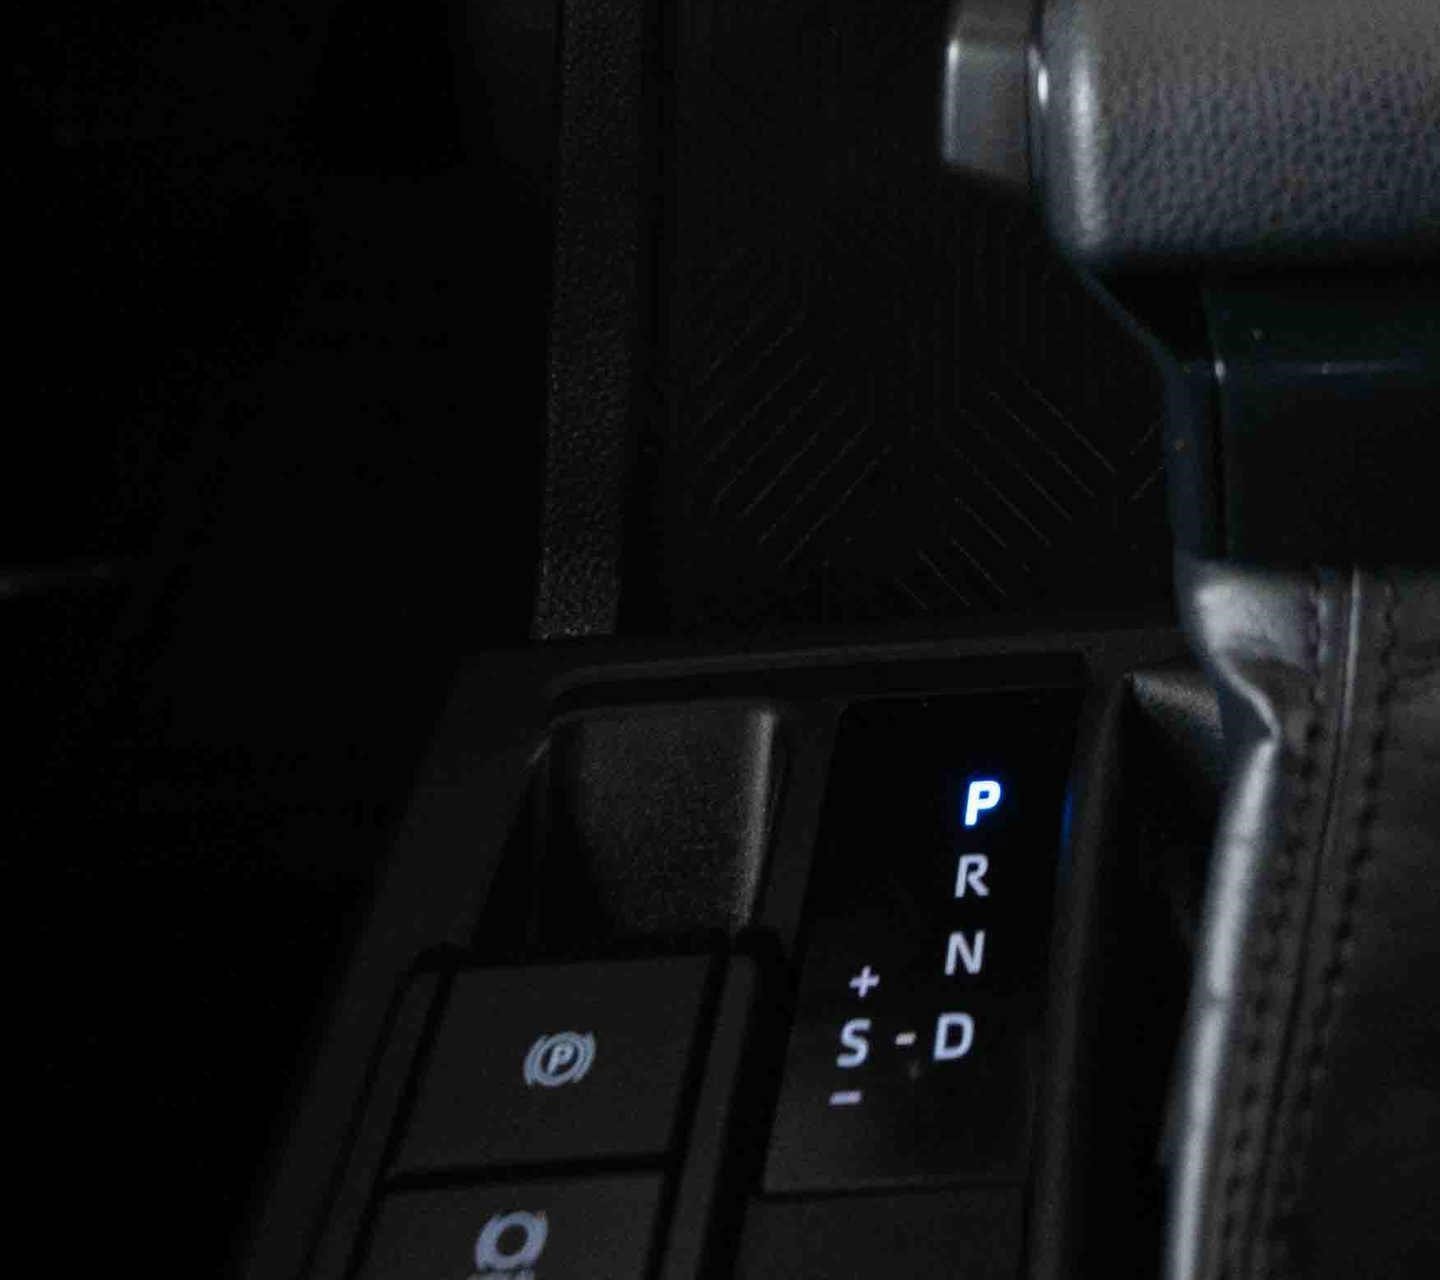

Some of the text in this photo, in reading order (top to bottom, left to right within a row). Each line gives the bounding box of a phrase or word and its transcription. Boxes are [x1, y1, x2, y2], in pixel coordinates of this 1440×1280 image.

[963, 778, 1004, 828] P
[954, 853, 989, 899] R
[944, 930, 986, 976] N
[836, 1012, 975, 1068] S D
